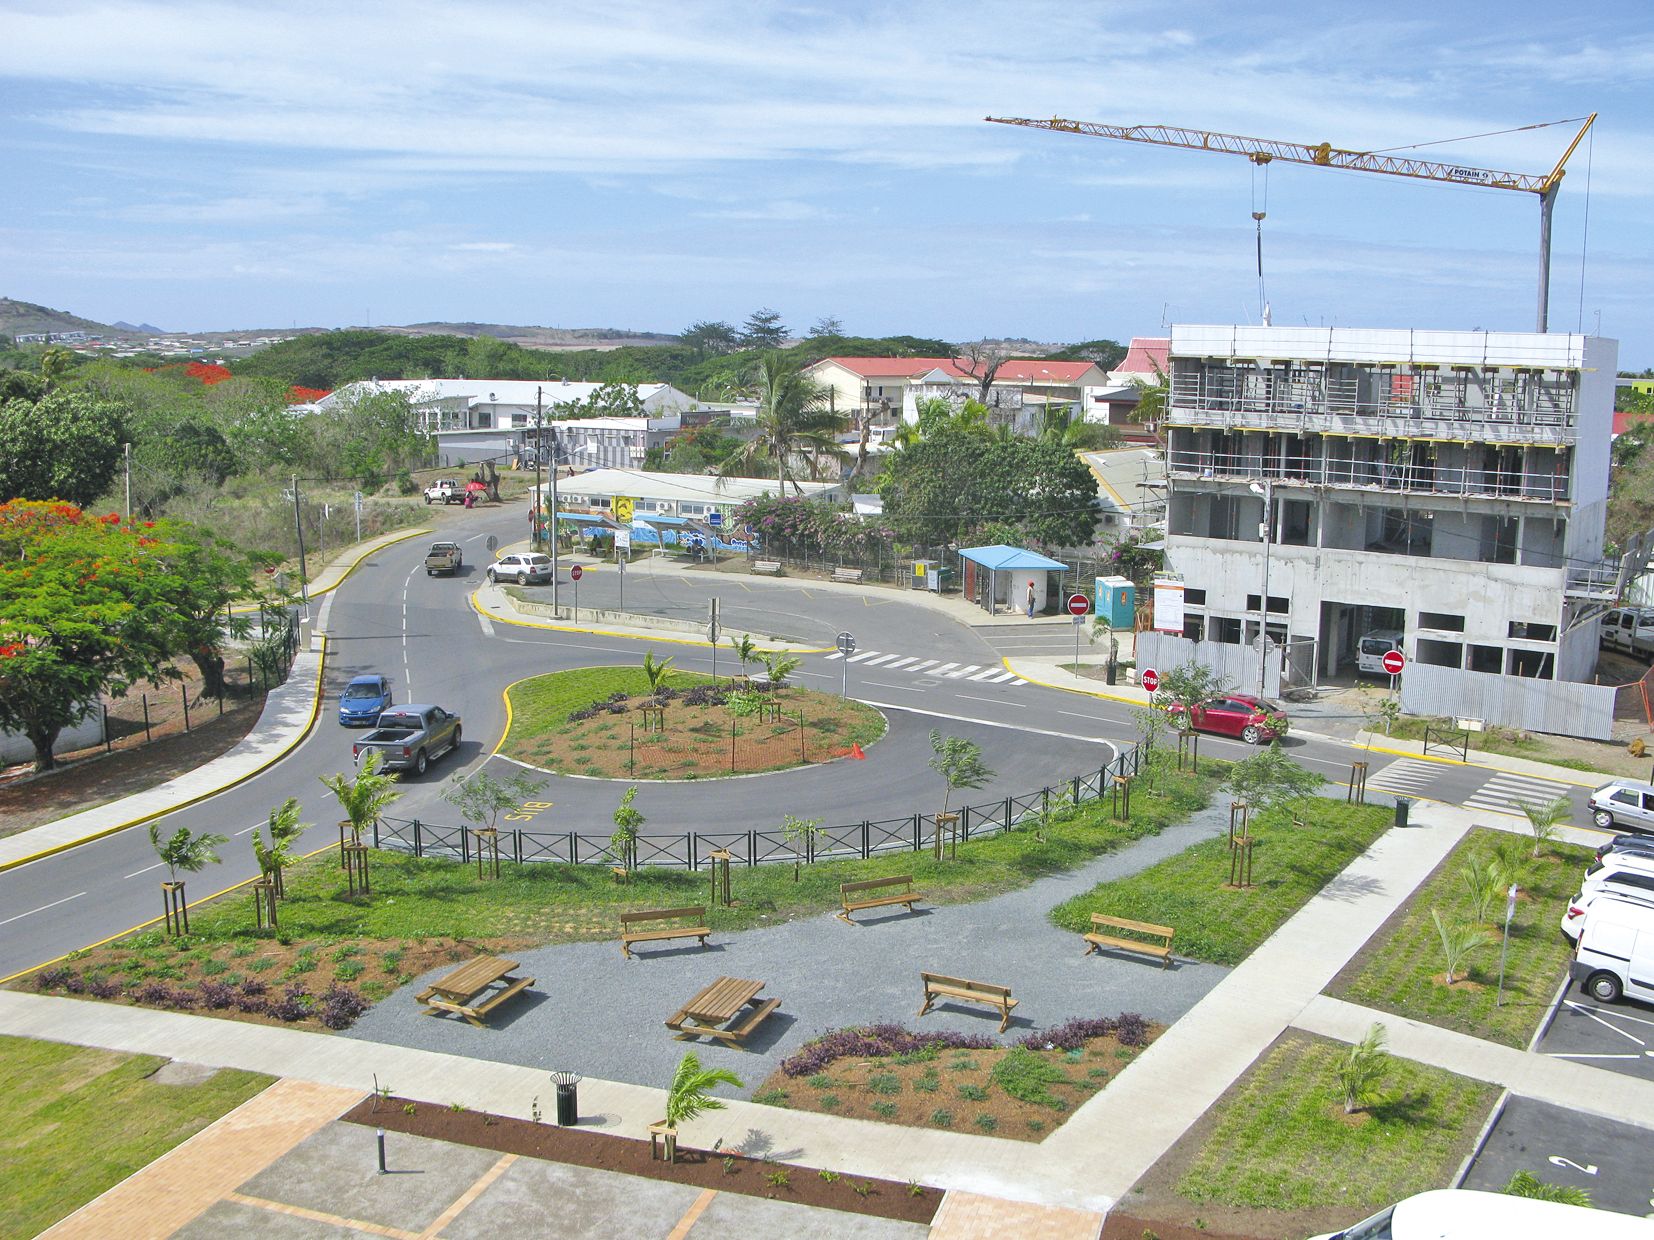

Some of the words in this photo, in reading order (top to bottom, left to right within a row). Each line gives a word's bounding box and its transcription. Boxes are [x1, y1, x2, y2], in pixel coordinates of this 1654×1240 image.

[1454, 168, 1480, 178] POTAIN
[1143, 676, 1158, 686] STOP
[504, 801, 553, 821] BUS
[1548, 1155, 1598, 1175] 2
